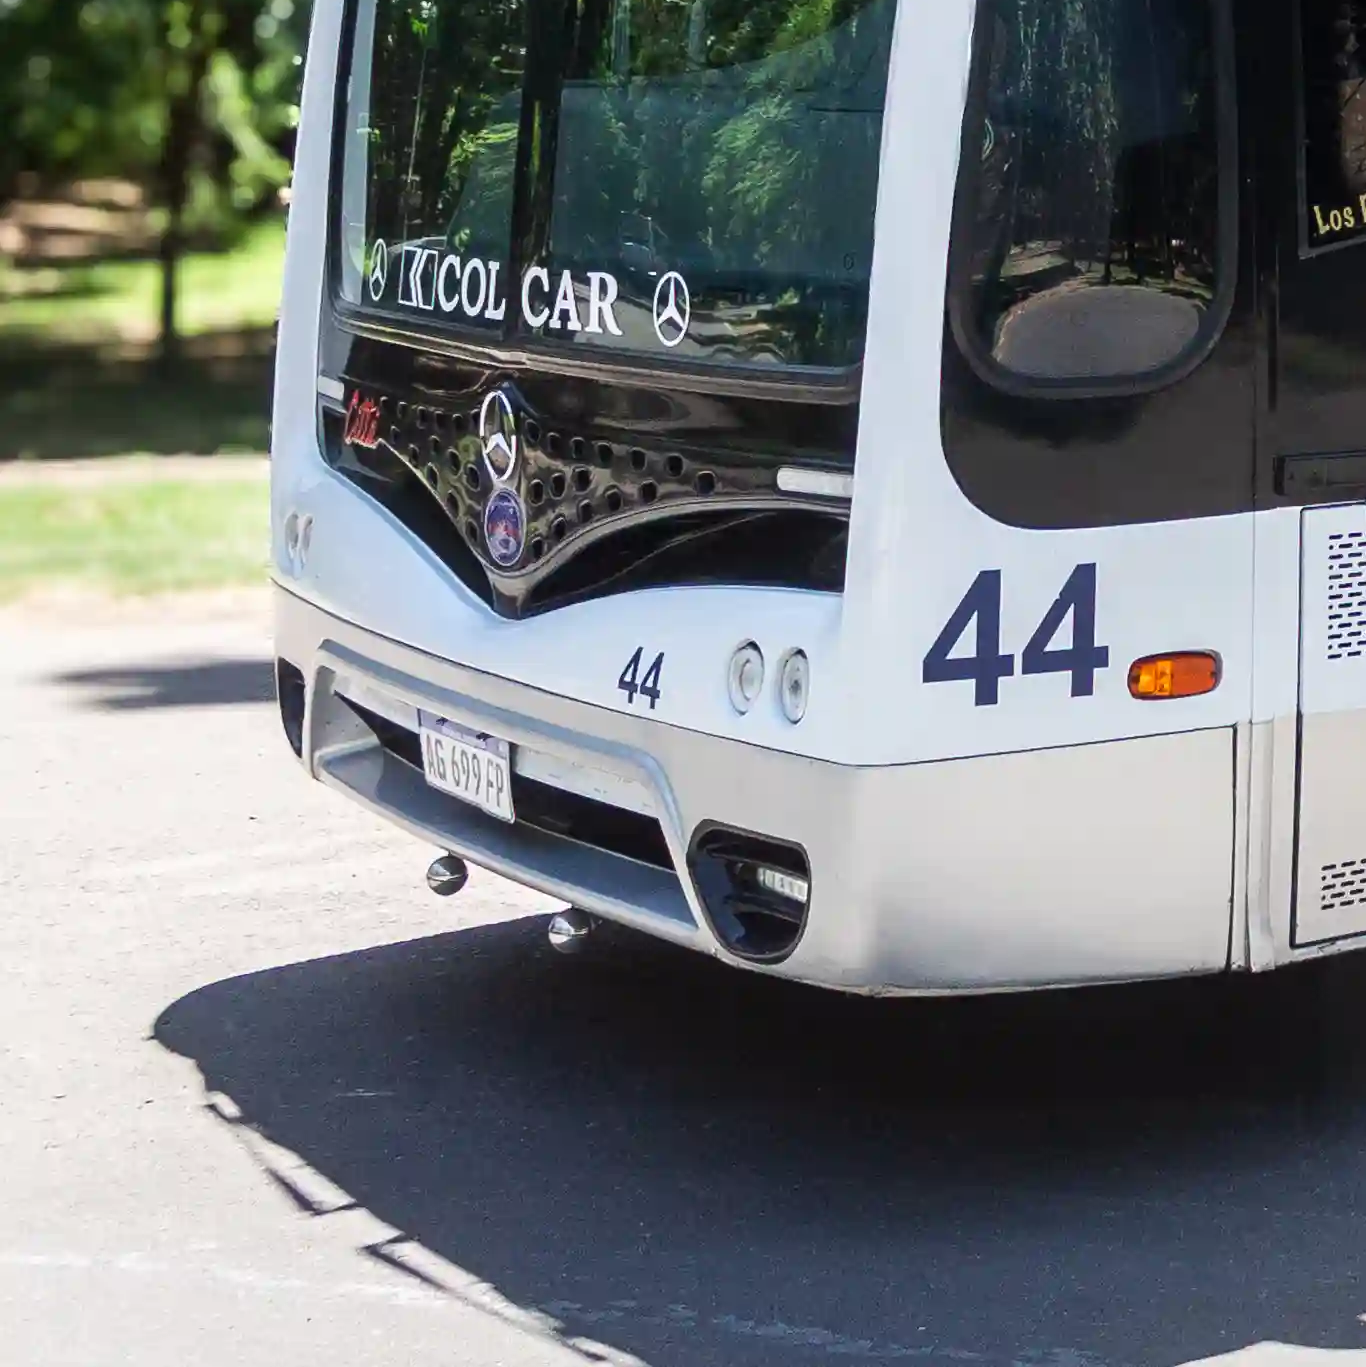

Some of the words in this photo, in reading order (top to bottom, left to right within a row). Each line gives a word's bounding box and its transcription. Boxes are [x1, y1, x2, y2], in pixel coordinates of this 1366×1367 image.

[1313, 205, 1355, 236] Los
[521, 266, 623, 336] CAR
[922, 562, 1110, 706] 44
[617, 646, 665, 710] 44
[426, 734, 447, 782] AG
[451, 745, 481, 796] 699
